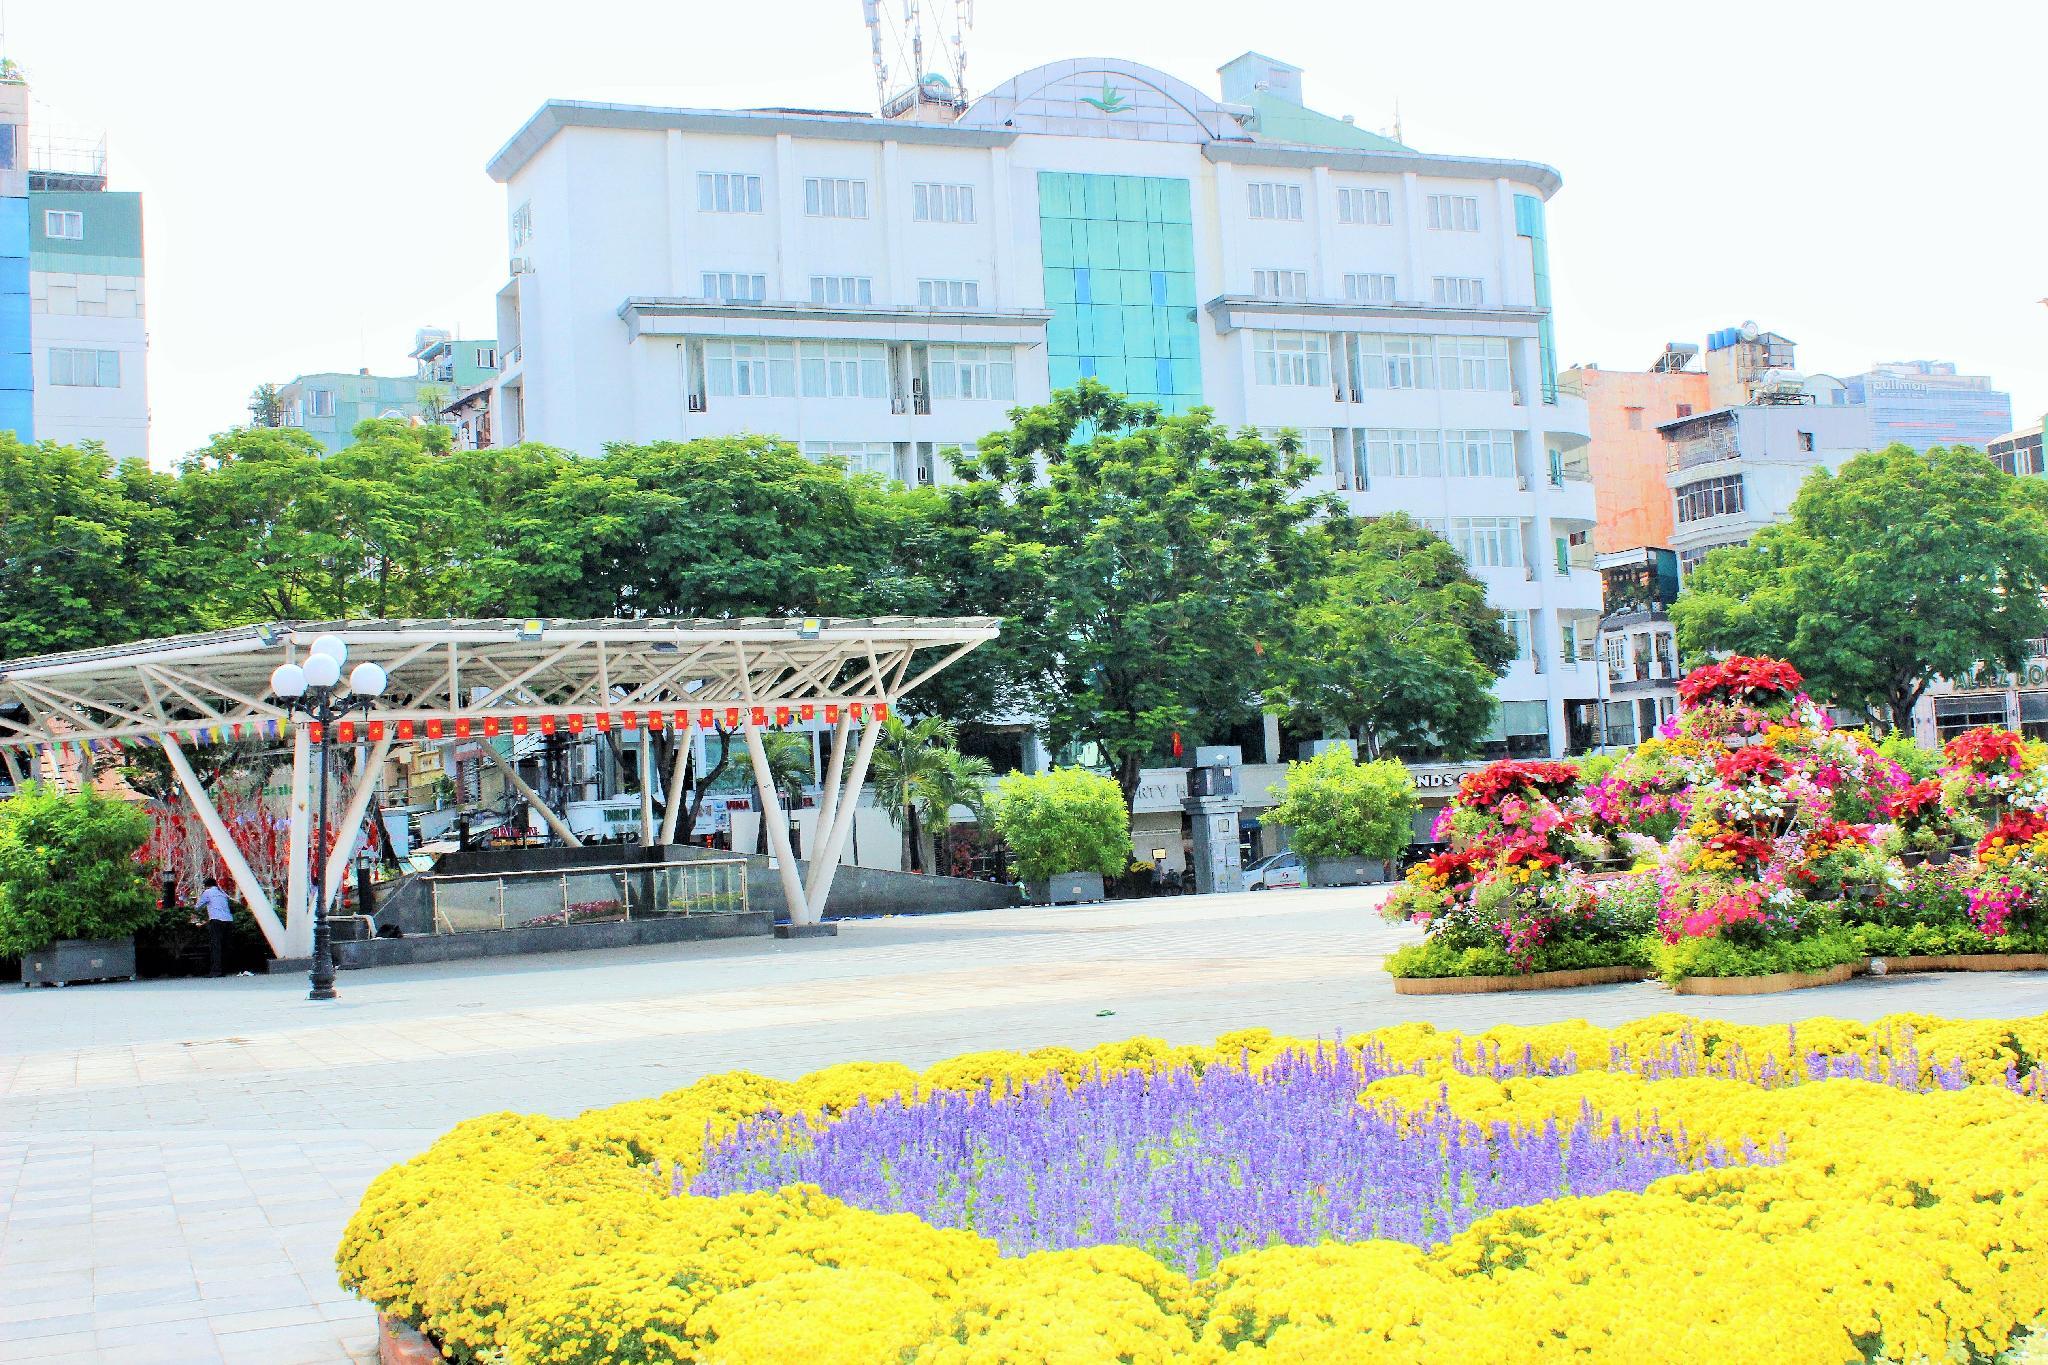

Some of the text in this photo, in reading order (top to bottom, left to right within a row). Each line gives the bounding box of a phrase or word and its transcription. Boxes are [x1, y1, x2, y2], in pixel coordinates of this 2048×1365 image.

[1872, 379, 1929, 395] pullman
[1416, 773, 1454, 788] NDS
[1138, 784, 1168, 800] RTY
